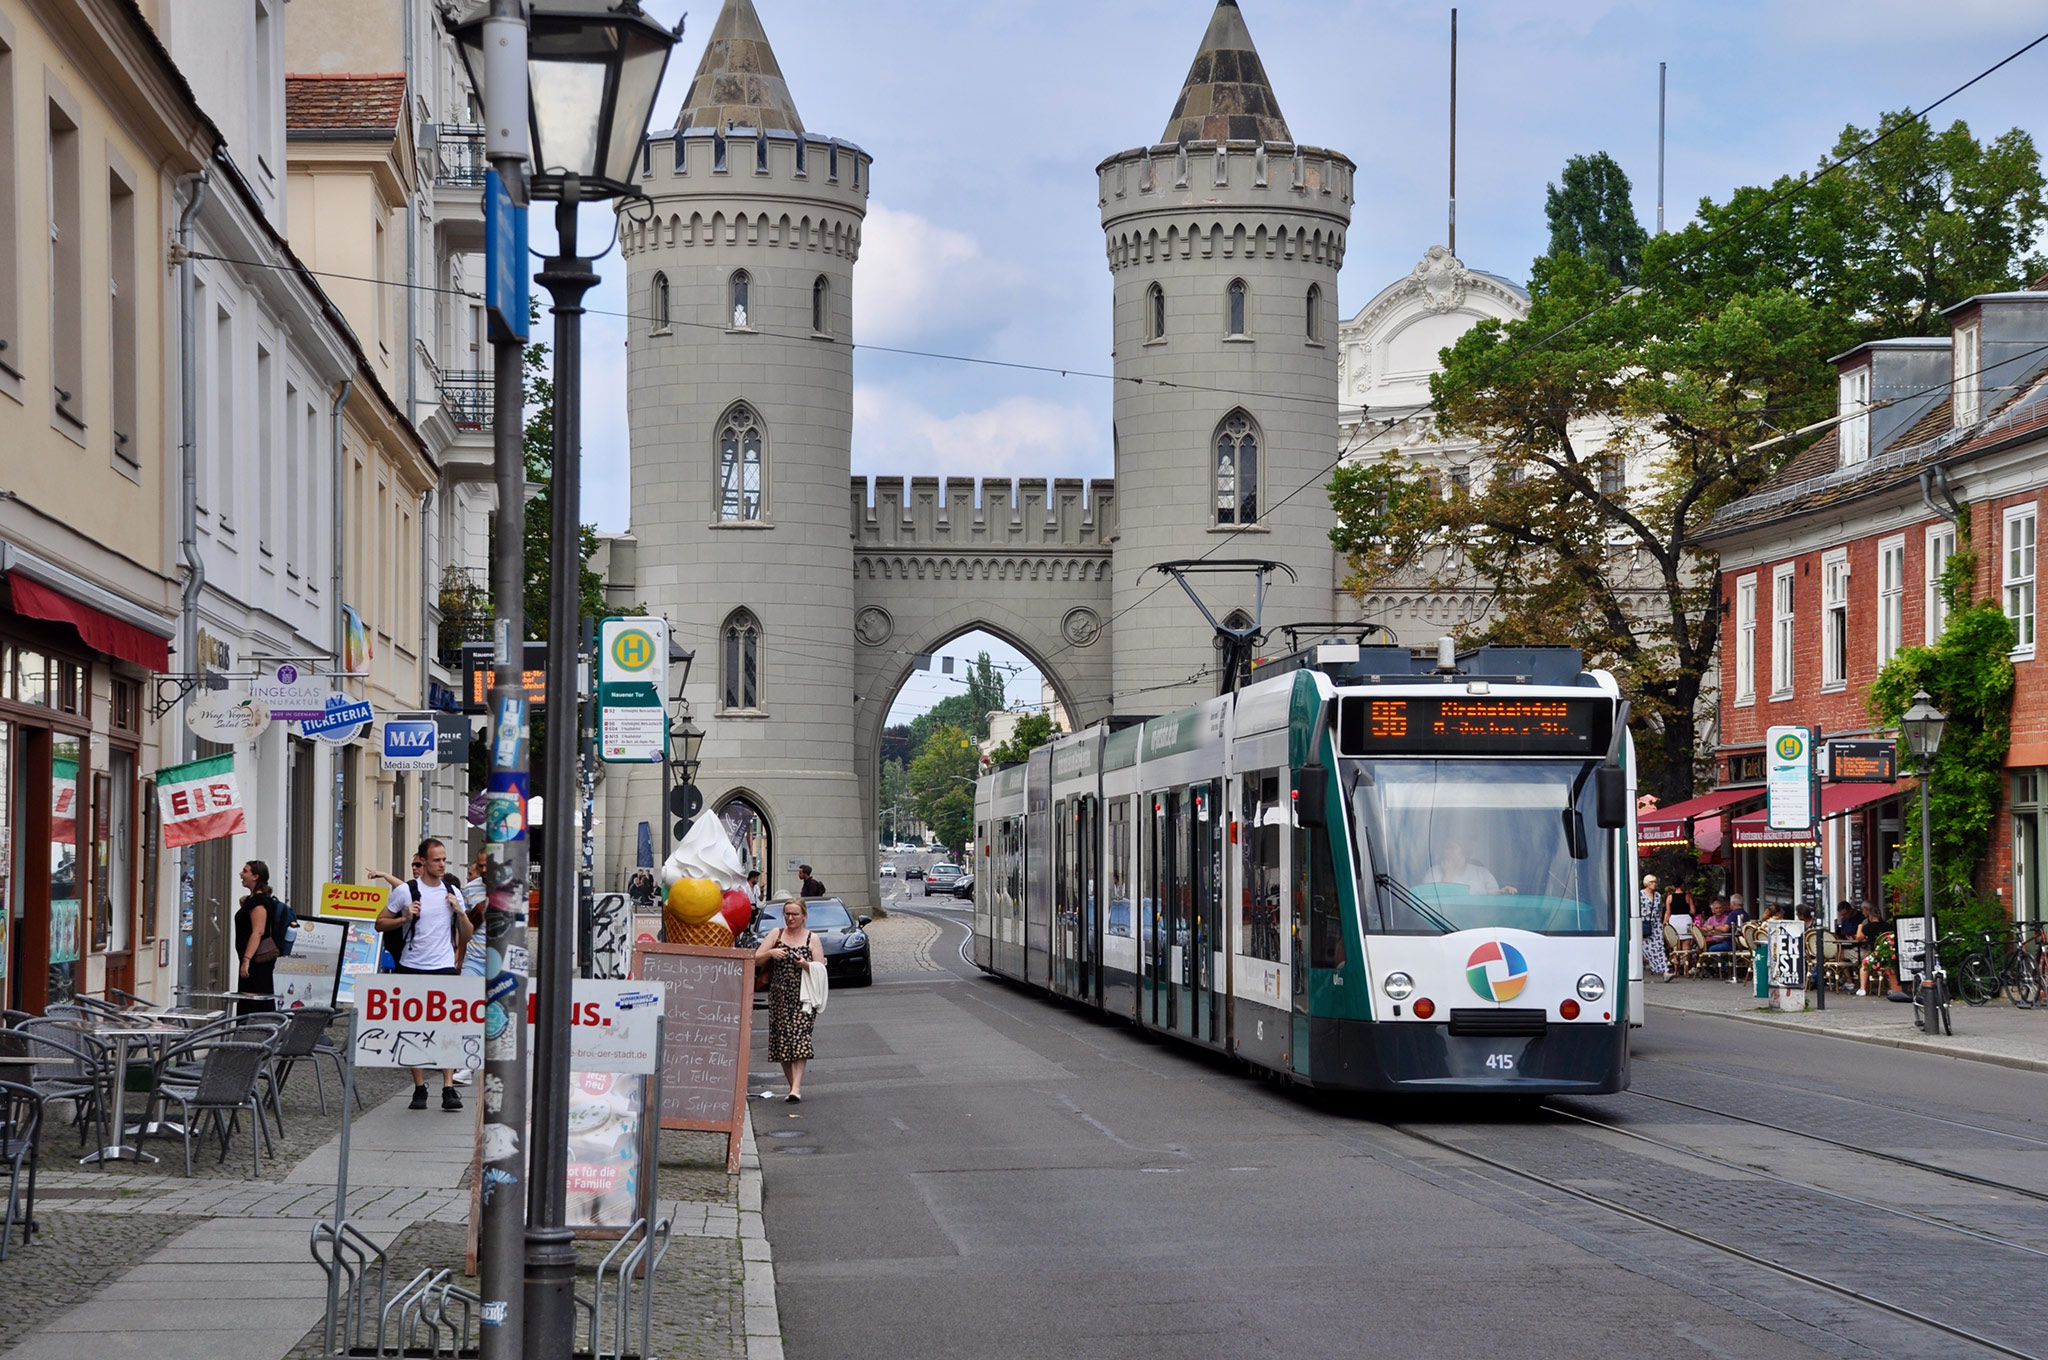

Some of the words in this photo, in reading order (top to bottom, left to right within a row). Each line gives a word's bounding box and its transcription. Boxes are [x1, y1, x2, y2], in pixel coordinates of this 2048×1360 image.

[258, 698, 320, 706] ANUFAKTUR
[326, 694, 346, 708] AZ
[200, 710, 224, 721] Wrap
[227, 709, 252, 721] Vegan
[303, 706, 369, 731] TICKETERIA
[1372, 702, 1408, 736] 96
[389, 730, 430, 747] MAZ
[384, 760, 411, 770] Media
[412, 760, 435, 770] Store
[171, 784, 232, 816] EIS
[344, 890, 381, 902] LOTTO
[643, 957, 688, 974] Frisch
[691, 961, 743, 983] gegrillte
[697, 1005, 740, 1024] Salate
[664, 1030, 727, 1047] oothies
[571, 1049, 647, 1059] e-brot-der-stadt.de
[709, 1051, 735, 1067] Teller
[1486, 1054, 1514, 1070] 415
[663, 1071, 681, 1083] fel
[691, 1071, 728, 1084] Teller
[585, 1080, 605, 1091] neu
[688, 1097, 730, 1113] Suppe
[582, 1167, 597, 1177] für
[600, 1167, 616, 1177] die
[574, 1179, 612, 1189] Familie
